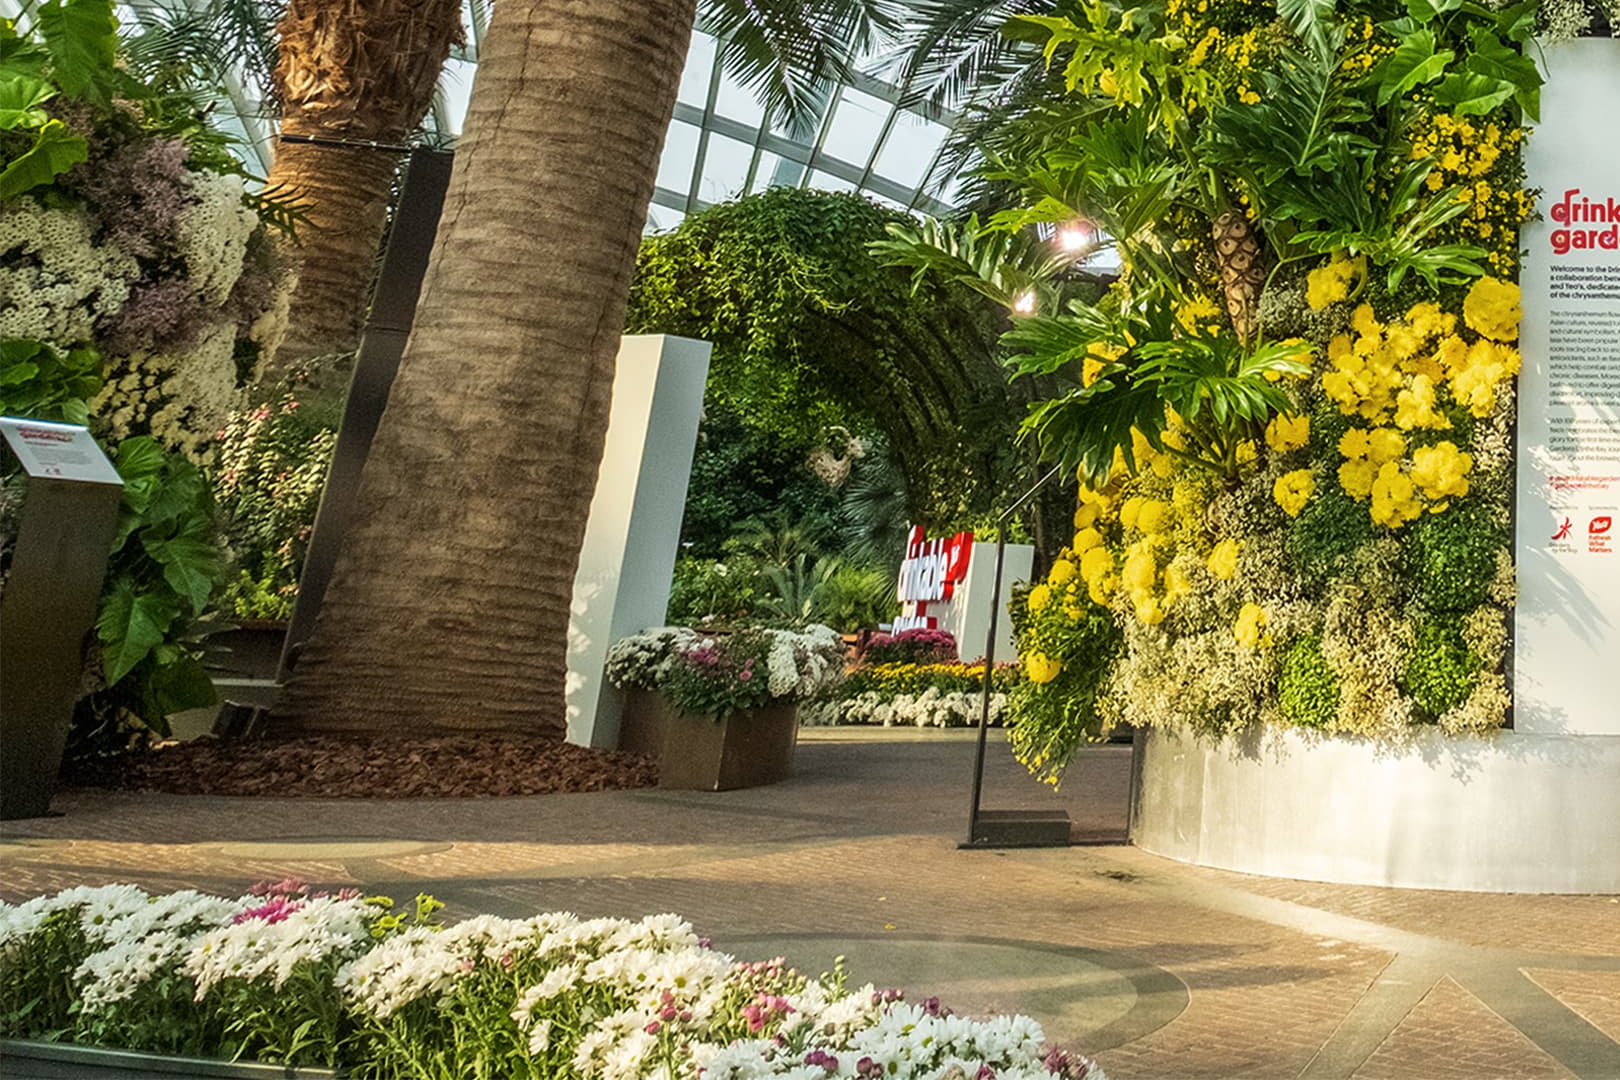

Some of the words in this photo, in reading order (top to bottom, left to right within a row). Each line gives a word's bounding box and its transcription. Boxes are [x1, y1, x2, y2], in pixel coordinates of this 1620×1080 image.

[1550, 265, 1585, 273] Welcome
[1595, 265, 1607, 273] the
[1555, 274, 1603, 282] collaboration
